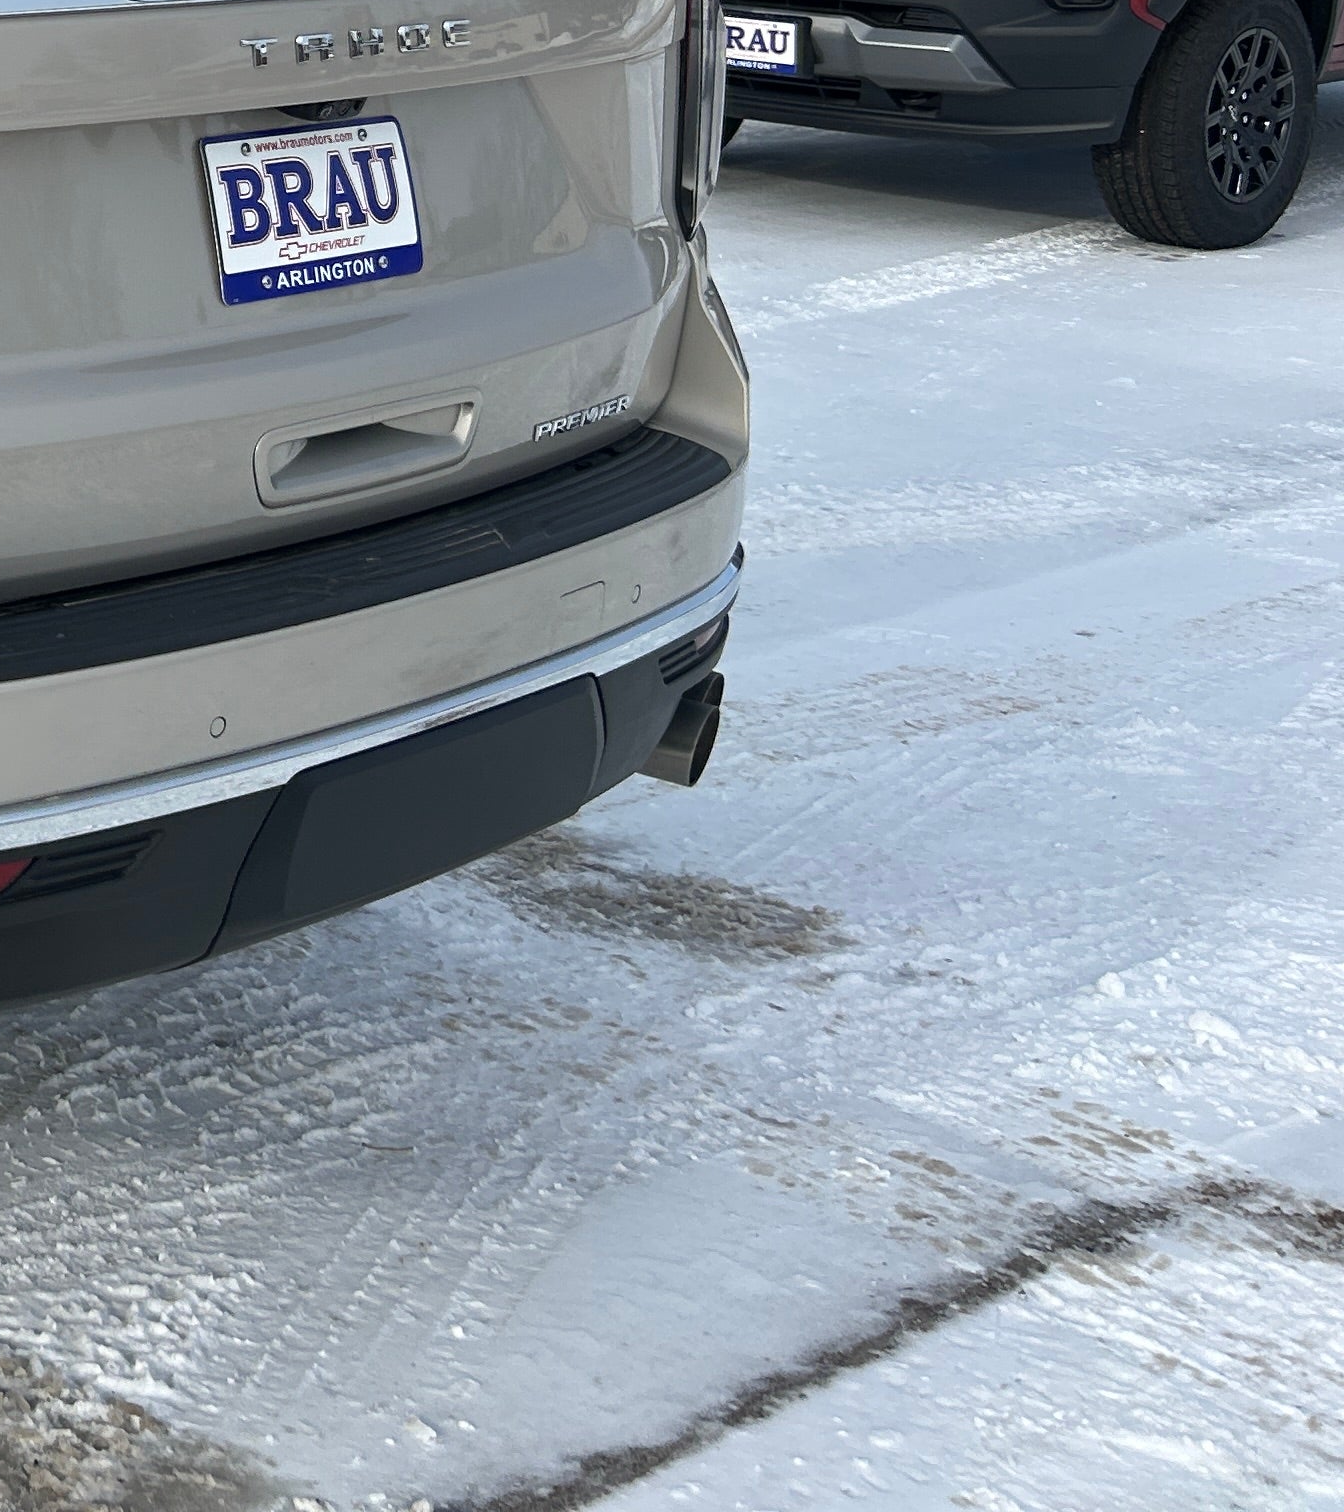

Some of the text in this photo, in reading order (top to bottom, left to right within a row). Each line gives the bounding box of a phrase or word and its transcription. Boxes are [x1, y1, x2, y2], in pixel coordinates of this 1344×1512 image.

[240, 19, 472, 69] TAHOE
[726, 26, 790, 55] RAU
[727, 58, 771, 70] RLINGTON
[254, 131, 353, 153] www.braumotors.com
[216, 143, 399, 248] BRAU
[309, 235, 365, 253] CHEVROLET
[277, 256, 375, 289] ARLINGTON
[533, 394, 631, 442] PREMIER
